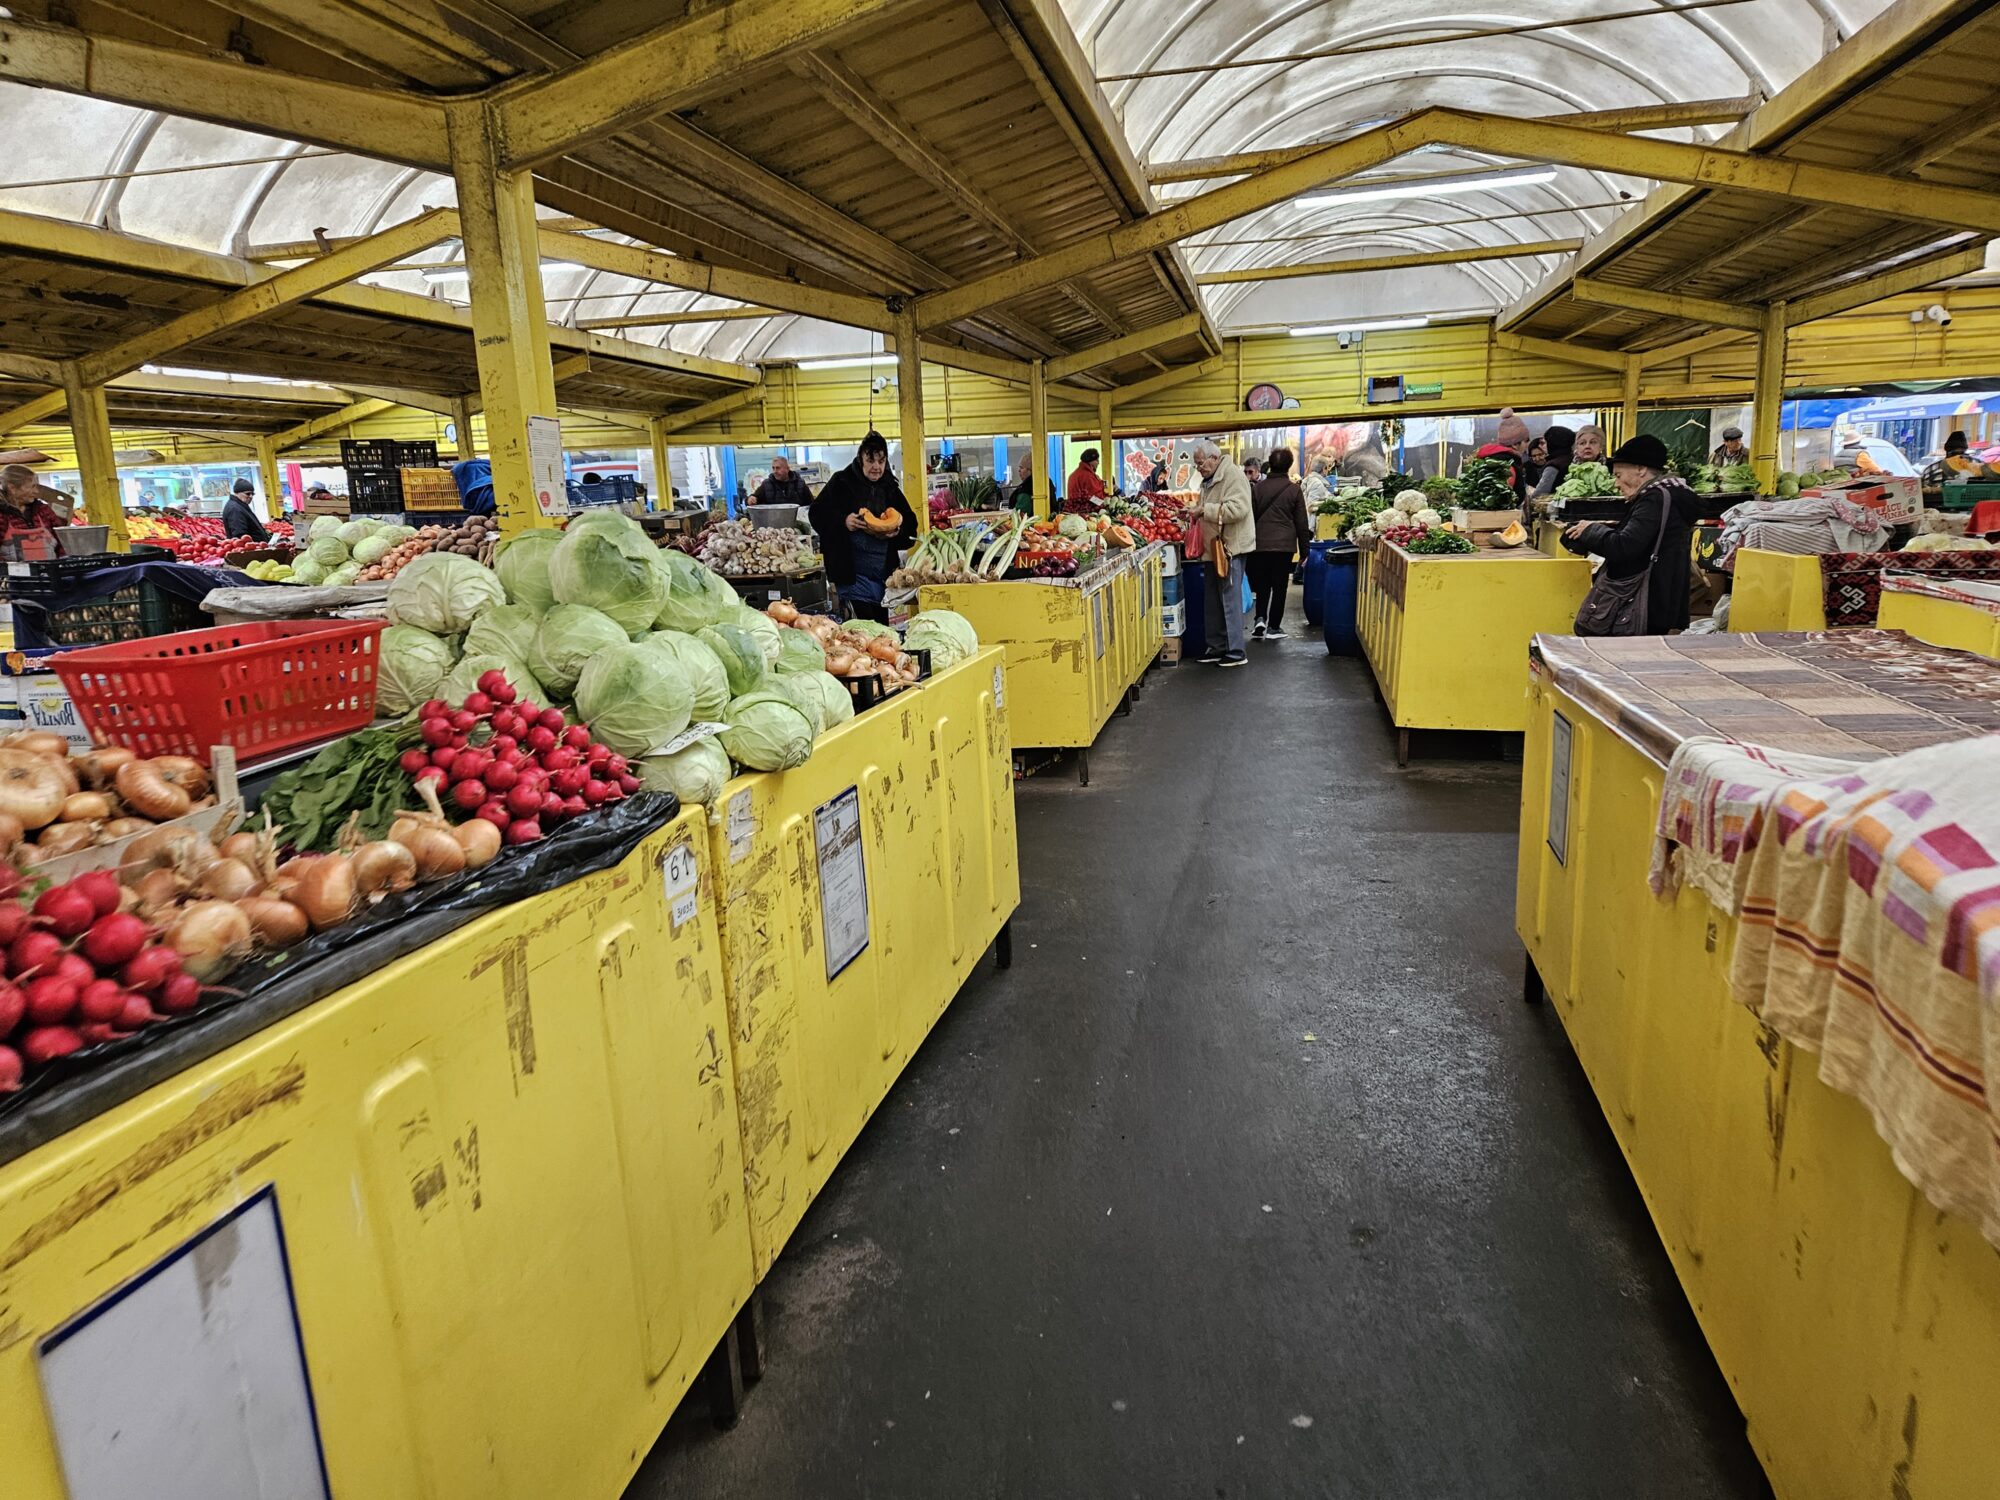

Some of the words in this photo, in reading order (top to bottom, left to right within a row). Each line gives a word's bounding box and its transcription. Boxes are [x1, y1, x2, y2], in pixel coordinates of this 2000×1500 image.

[1019, 556, 1045, 568] Na
[30, 701, 76, 726] BONITA
[671, 851, 689, 880] 61
